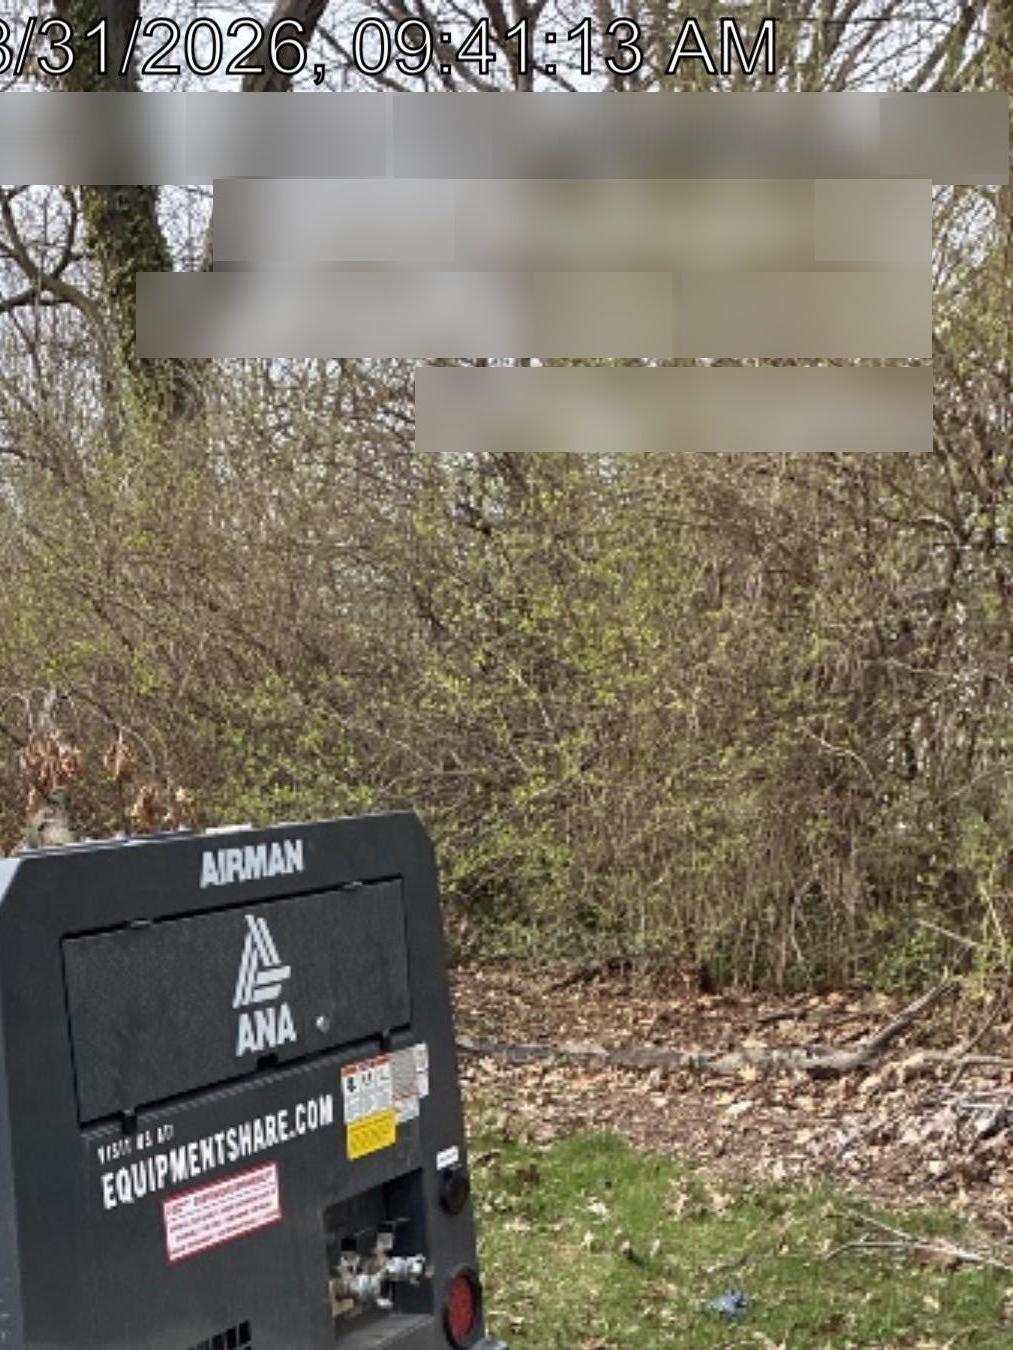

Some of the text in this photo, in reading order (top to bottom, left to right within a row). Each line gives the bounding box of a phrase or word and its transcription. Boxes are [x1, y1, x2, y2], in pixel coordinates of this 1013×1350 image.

[200, 839, 304, 888] AIRMAN
[235, 1003, 296, 1056] ANA
[101, 1094, 333, 1210] EQUIPMENTSHARE.COM
